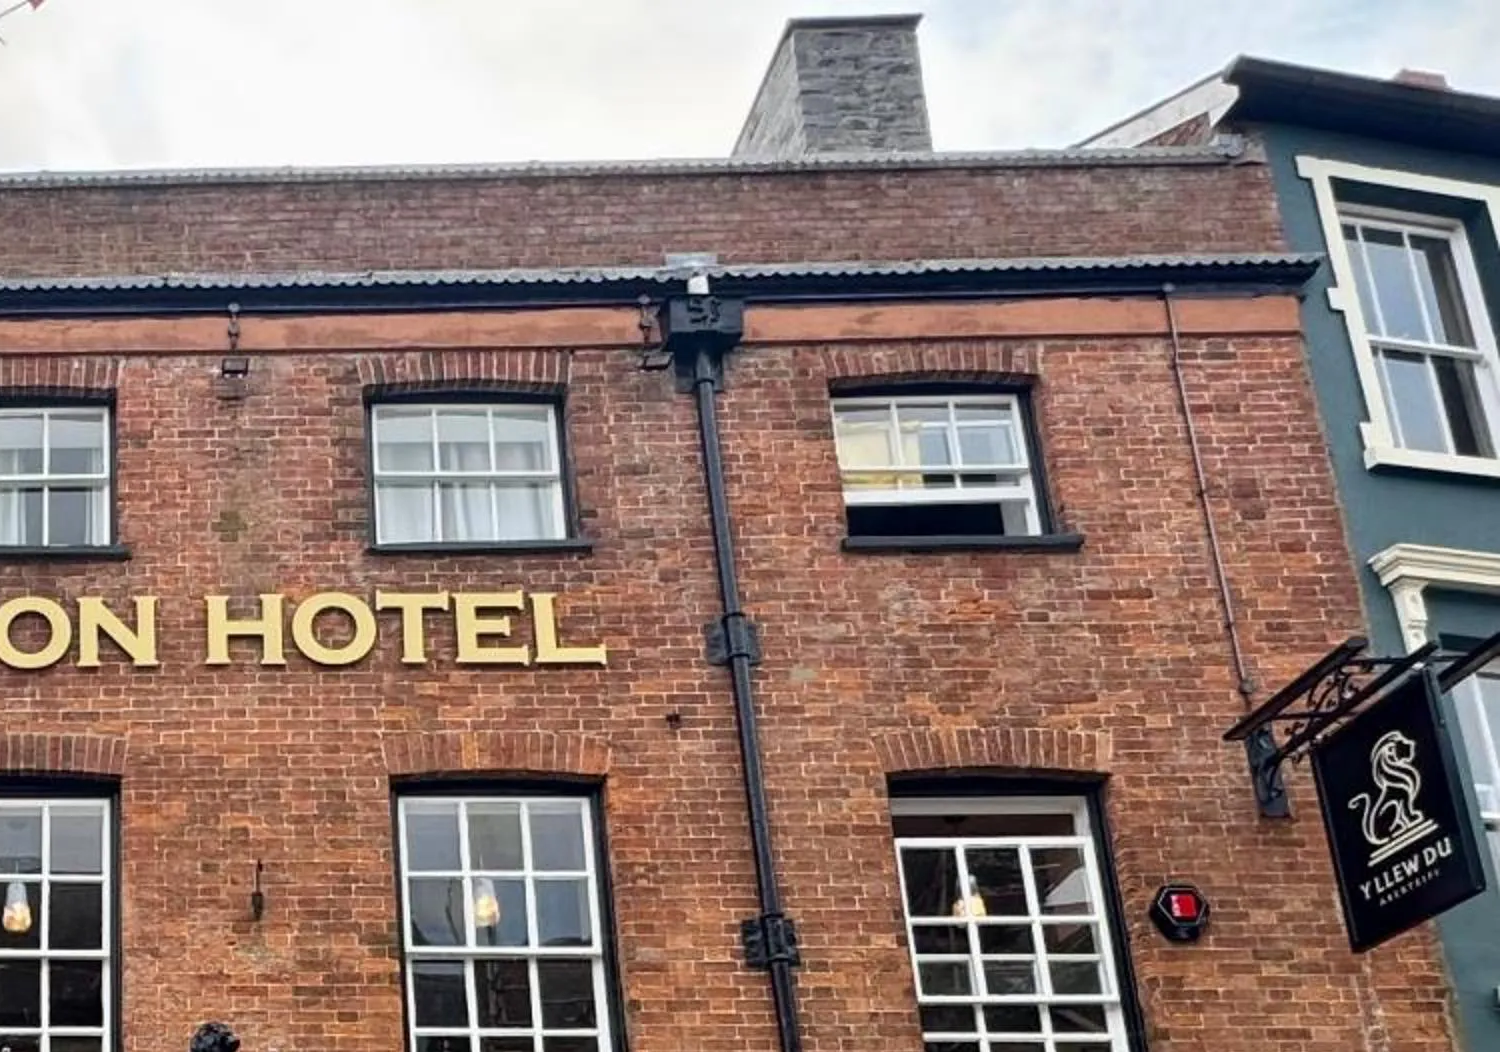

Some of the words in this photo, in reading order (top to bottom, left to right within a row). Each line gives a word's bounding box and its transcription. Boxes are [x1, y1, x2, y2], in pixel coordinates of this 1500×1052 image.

[204, 590, 607, 666] HOTEL
[1360, 880, 1371, 900] Y
[1373, 853, 1420, 894] LLEW
[1422, 836, 1453, 867] DU
